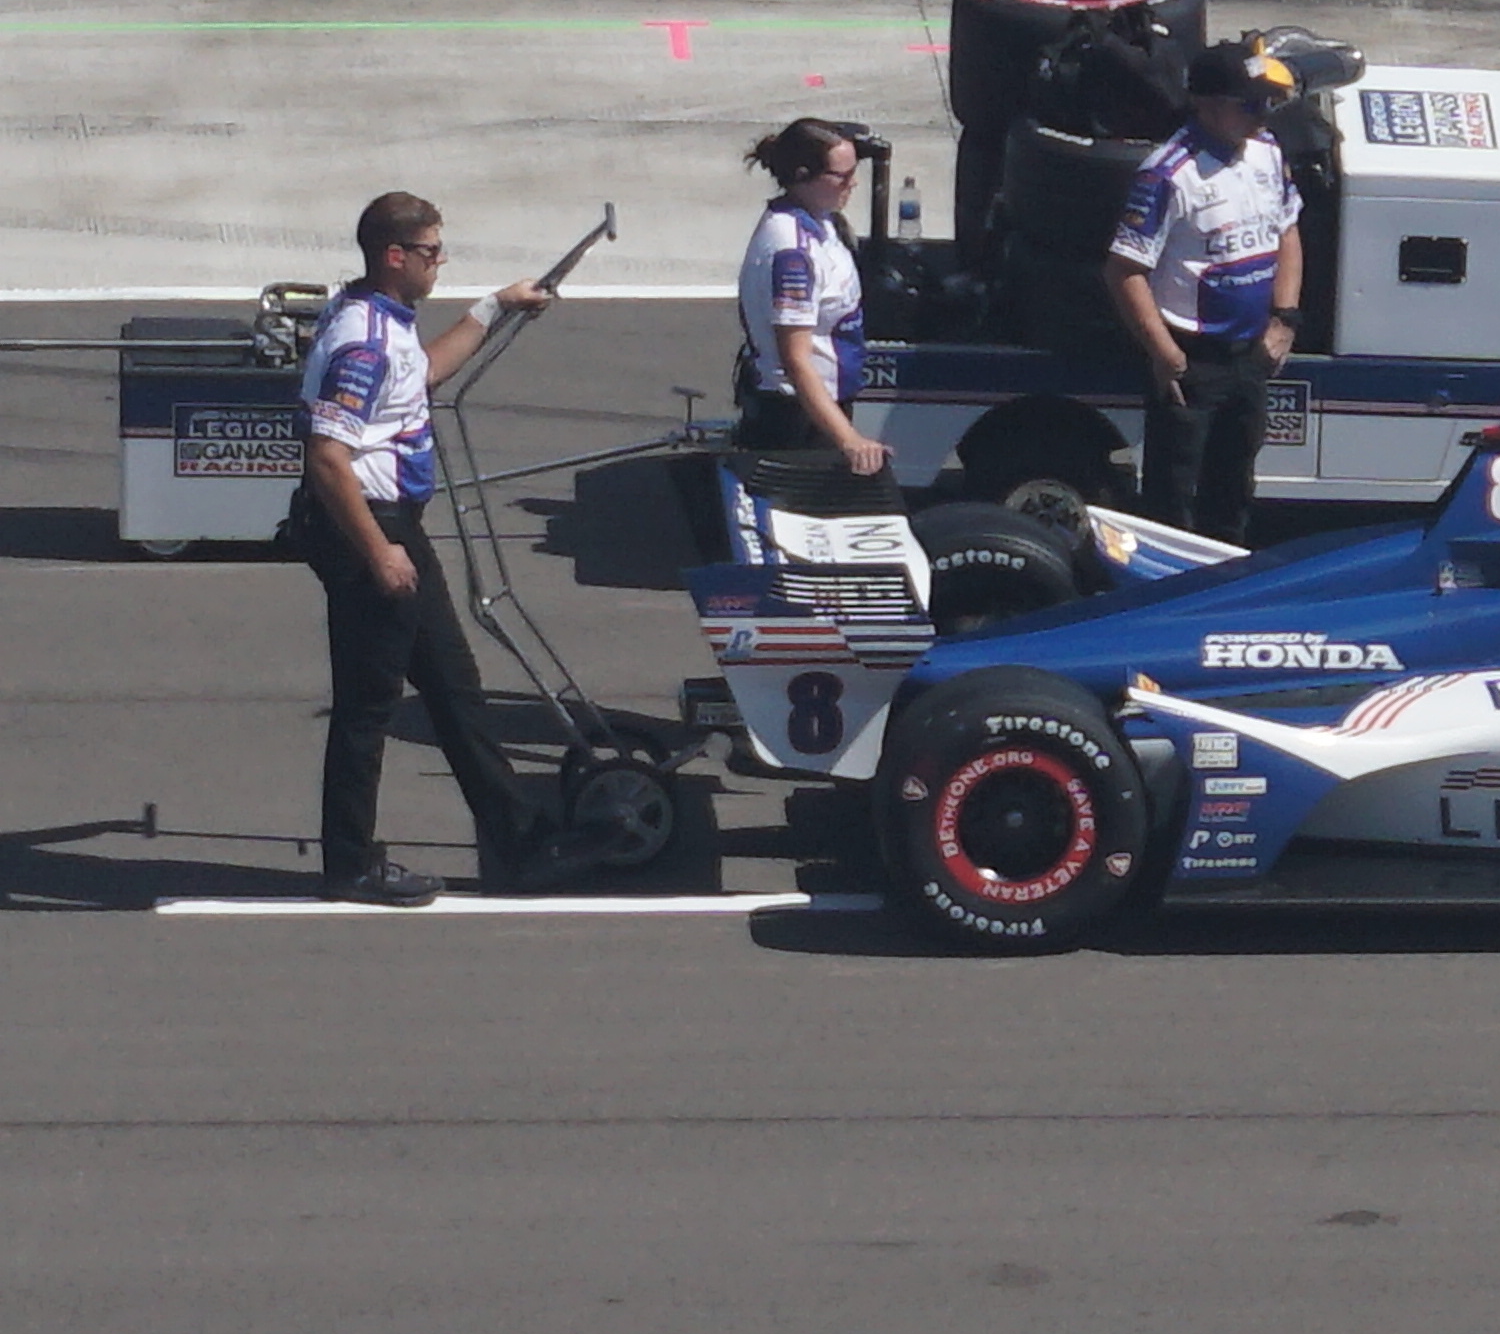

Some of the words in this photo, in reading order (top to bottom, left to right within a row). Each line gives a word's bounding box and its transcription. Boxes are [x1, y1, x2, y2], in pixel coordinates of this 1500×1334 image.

[188, 421, 294, 438] LEGION
[1203, 643, 1404, 671] HONDA
[786, 670, 846, 755] 8
[985, 714, 1112, 770] Firestone
[1066, 777, 1096, 831] SAVE
[983, 852, 1084, 904] VETERAN
[924, 879, 1046, 937] Firestone
